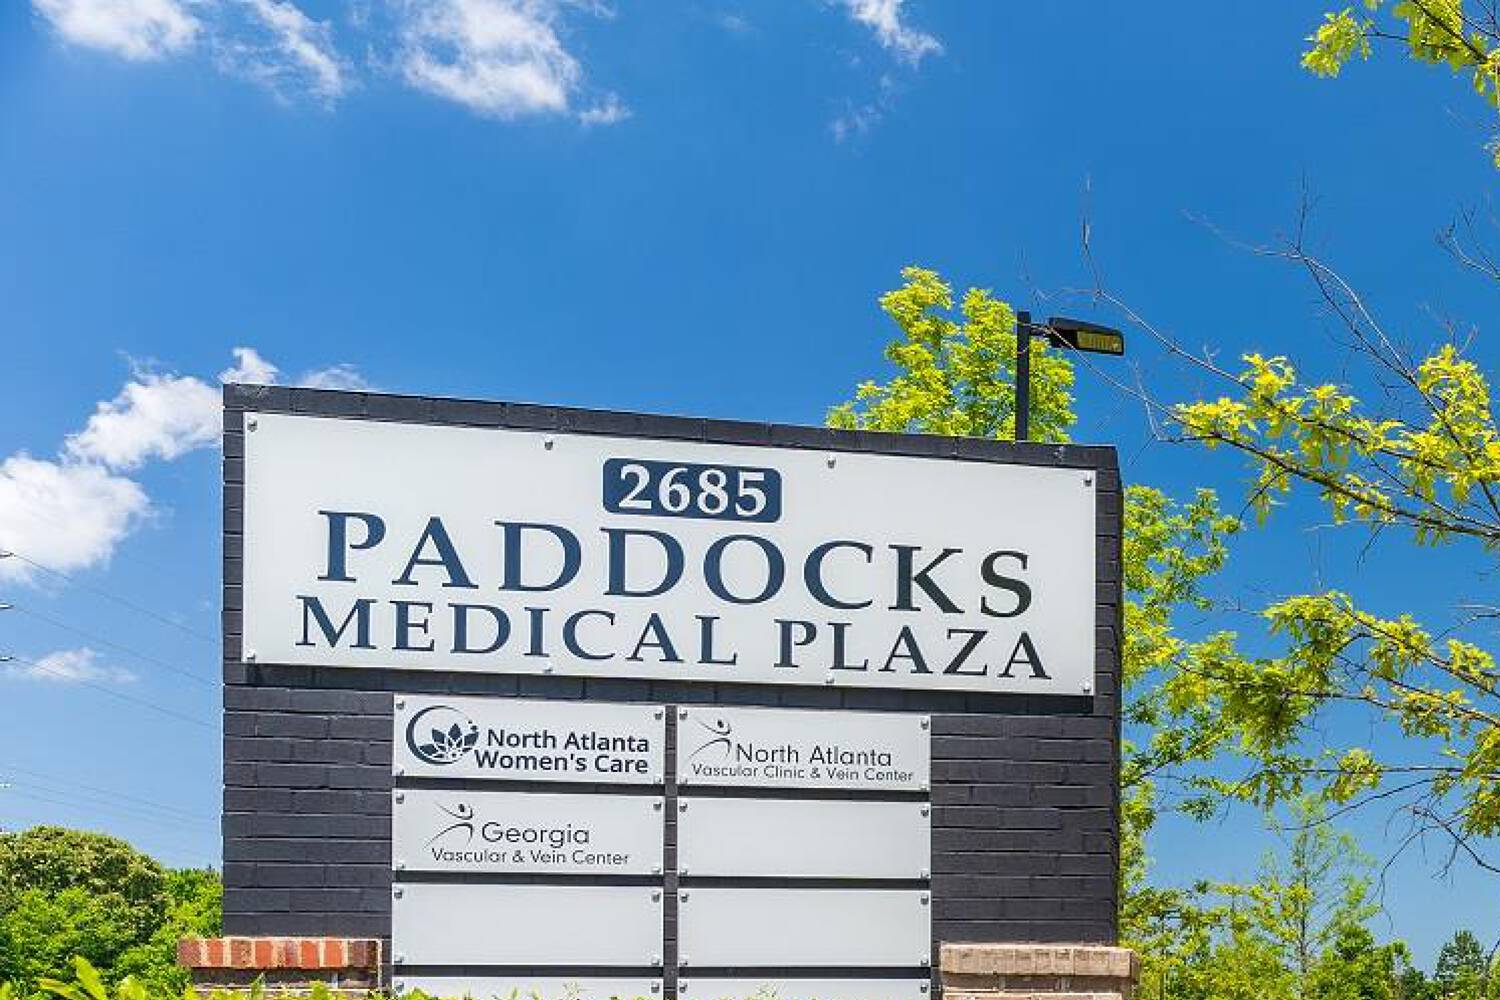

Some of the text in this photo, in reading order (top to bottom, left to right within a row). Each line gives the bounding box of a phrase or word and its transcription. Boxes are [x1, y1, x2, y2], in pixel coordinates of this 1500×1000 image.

[618, 463, 769, 518] 2685
[317, 510, 1032, 618] PADDOCKS
[295, 594, 1053, 681] MEDICAL PLAZA
[487, 729, 650, 753] North Atlanta
[473, 750, 648, 774] Women's Care
[735, 743, 892, 767] North Atlanta
[691, 763, 914, 783] Vascular Clinic & Vein Center
[481, 821, 590, 849] Georgia
[431, 847, 629, 865] Vascular & Vein Center
